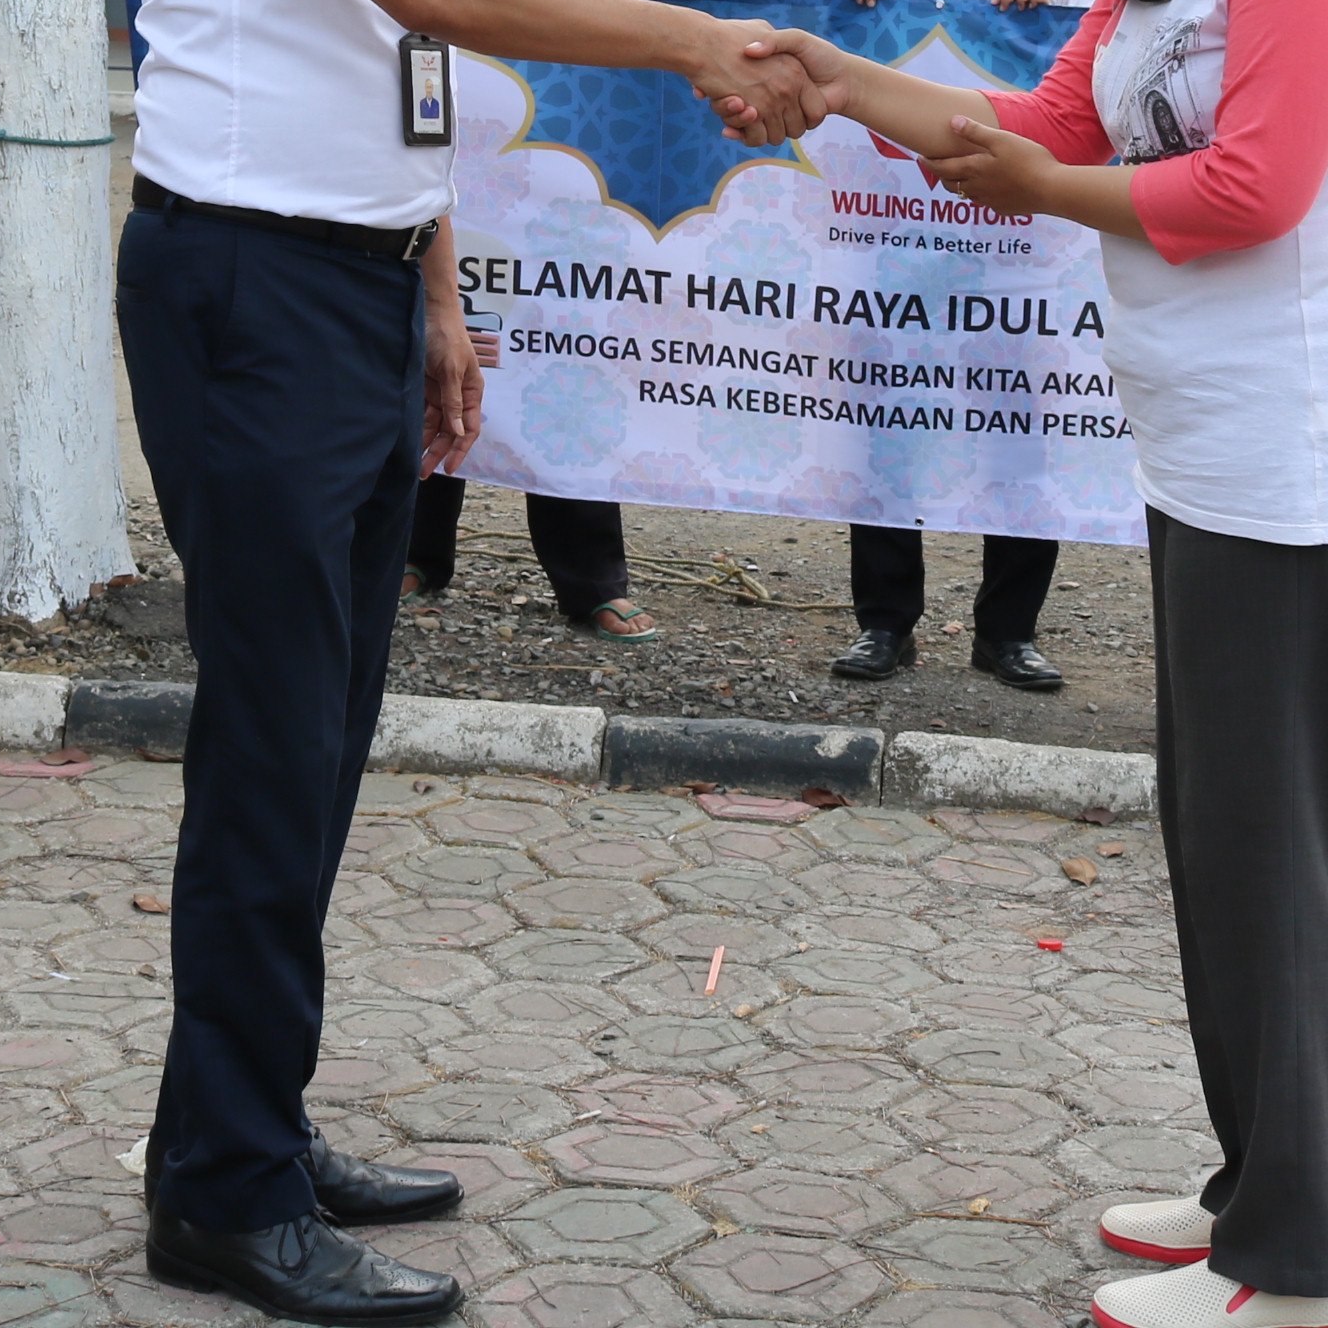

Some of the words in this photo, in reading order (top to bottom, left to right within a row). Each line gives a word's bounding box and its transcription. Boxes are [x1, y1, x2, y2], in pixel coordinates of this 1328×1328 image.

[831, 189, 924, 222] WULING
[829, 226, 875, 245] Drive
[881, 231, 910, 248] For
[915, 235, 927, 250] A
[933, 236, 992, 253] Better
[998, 238, 1032, 254] Life
[458, 256, 672, 305] SELAMAT
[687, 273, 796, 320] HARI
[813, 285, 931, 331] RAYA
[947, 295, 1058, 336] IDUL
[1072, 301, 1104, 339] A
[509, 328, 642, 362] SEMOGA
[651, 339, 819, 378] SEMANGAT
[828, 357, 954, 389] KURBAN
[966, 367, 1032, 394] KITA
[638, 379, 717, 409] RASA
[726, 386, 954, 431] KEBERSAMAAN
[965, 409, 1031, 435] DAN
